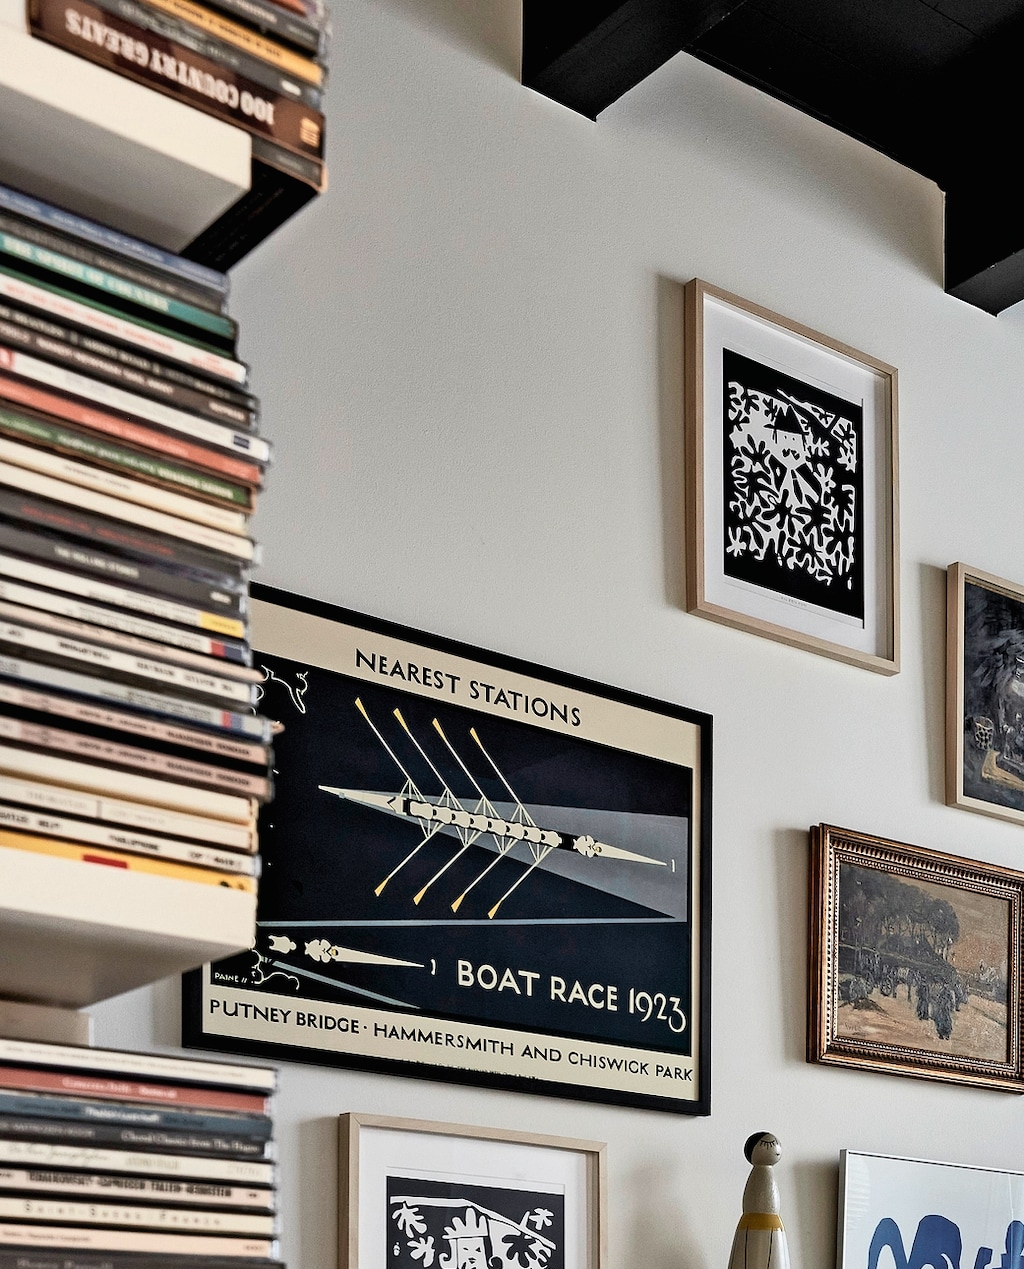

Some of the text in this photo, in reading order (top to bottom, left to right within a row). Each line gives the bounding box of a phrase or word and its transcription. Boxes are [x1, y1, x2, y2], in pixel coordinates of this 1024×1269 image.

[64, 8, 150, 67] GREATS
[150, 50, 240, 110] COUNTRY
[355, 648, 581, 727] NEAREST STATIONS
[457, 959, 687, 1033] BOAT RACE 1923
[210, 999, 292, 1024] PUTNEY
[296, 1011, 360, 1035] BRIDGE
[374, 1022, 514, 1056] HAMMERSMITH
[520, 1044, 562, 1062] AND
[568, 1051, 649, 1076] CHISWICK
[655, 1064, 693, 1082] PARK
